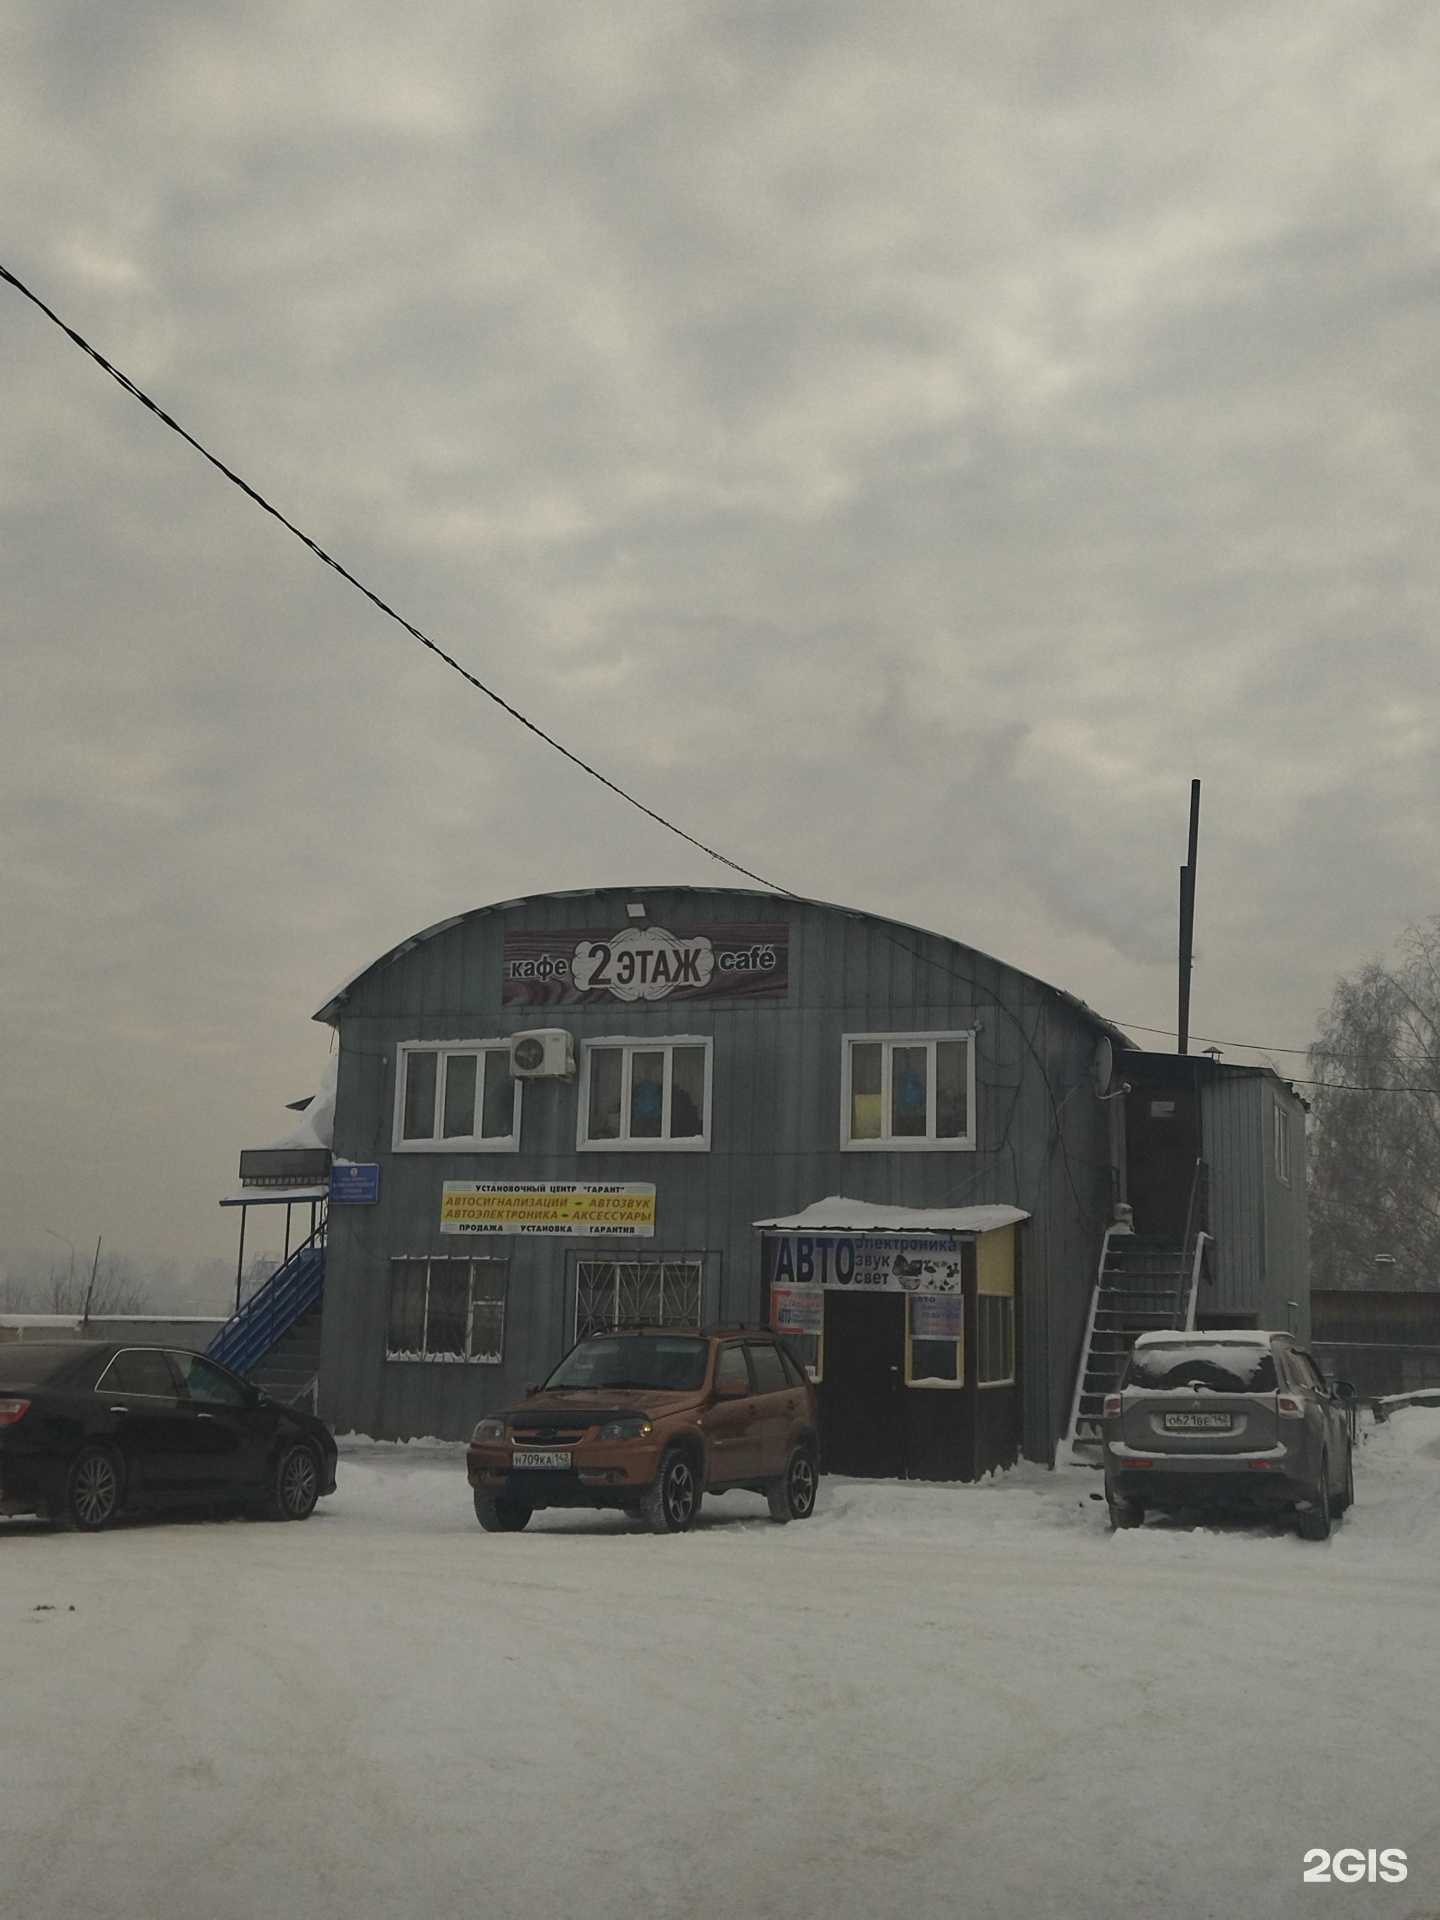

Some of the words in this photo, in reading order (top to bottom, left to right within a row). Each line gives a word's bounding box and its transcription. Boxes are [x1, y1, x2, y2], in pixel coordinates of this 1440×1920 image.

[588, 944, 612, 986] 2
[616, 949, 701, 984] ЭТАЖ
[719, 944, 776, 972] café
[511, 955, 568, 985] кафе
[475, 1184, 546, 1193] УСТАНОВОЧНЫЙ
[550, 1185, 577, 1194] ЦЕНТР
[589, 1198, 650, 1209] АВТОЗВУК
[446, 1209, 558, 1220] АВТОЭЛЕКТРОНИКА
[459, 1224, 503, 1232] ПРОДАЖА
[520, 1224, 573, 1233] УСТАНОВКА
[776, 1238, 855, 1285] АВТО
[855, 1255, 890, 1271] звук
[854, 1272, 889, 1285] свет
